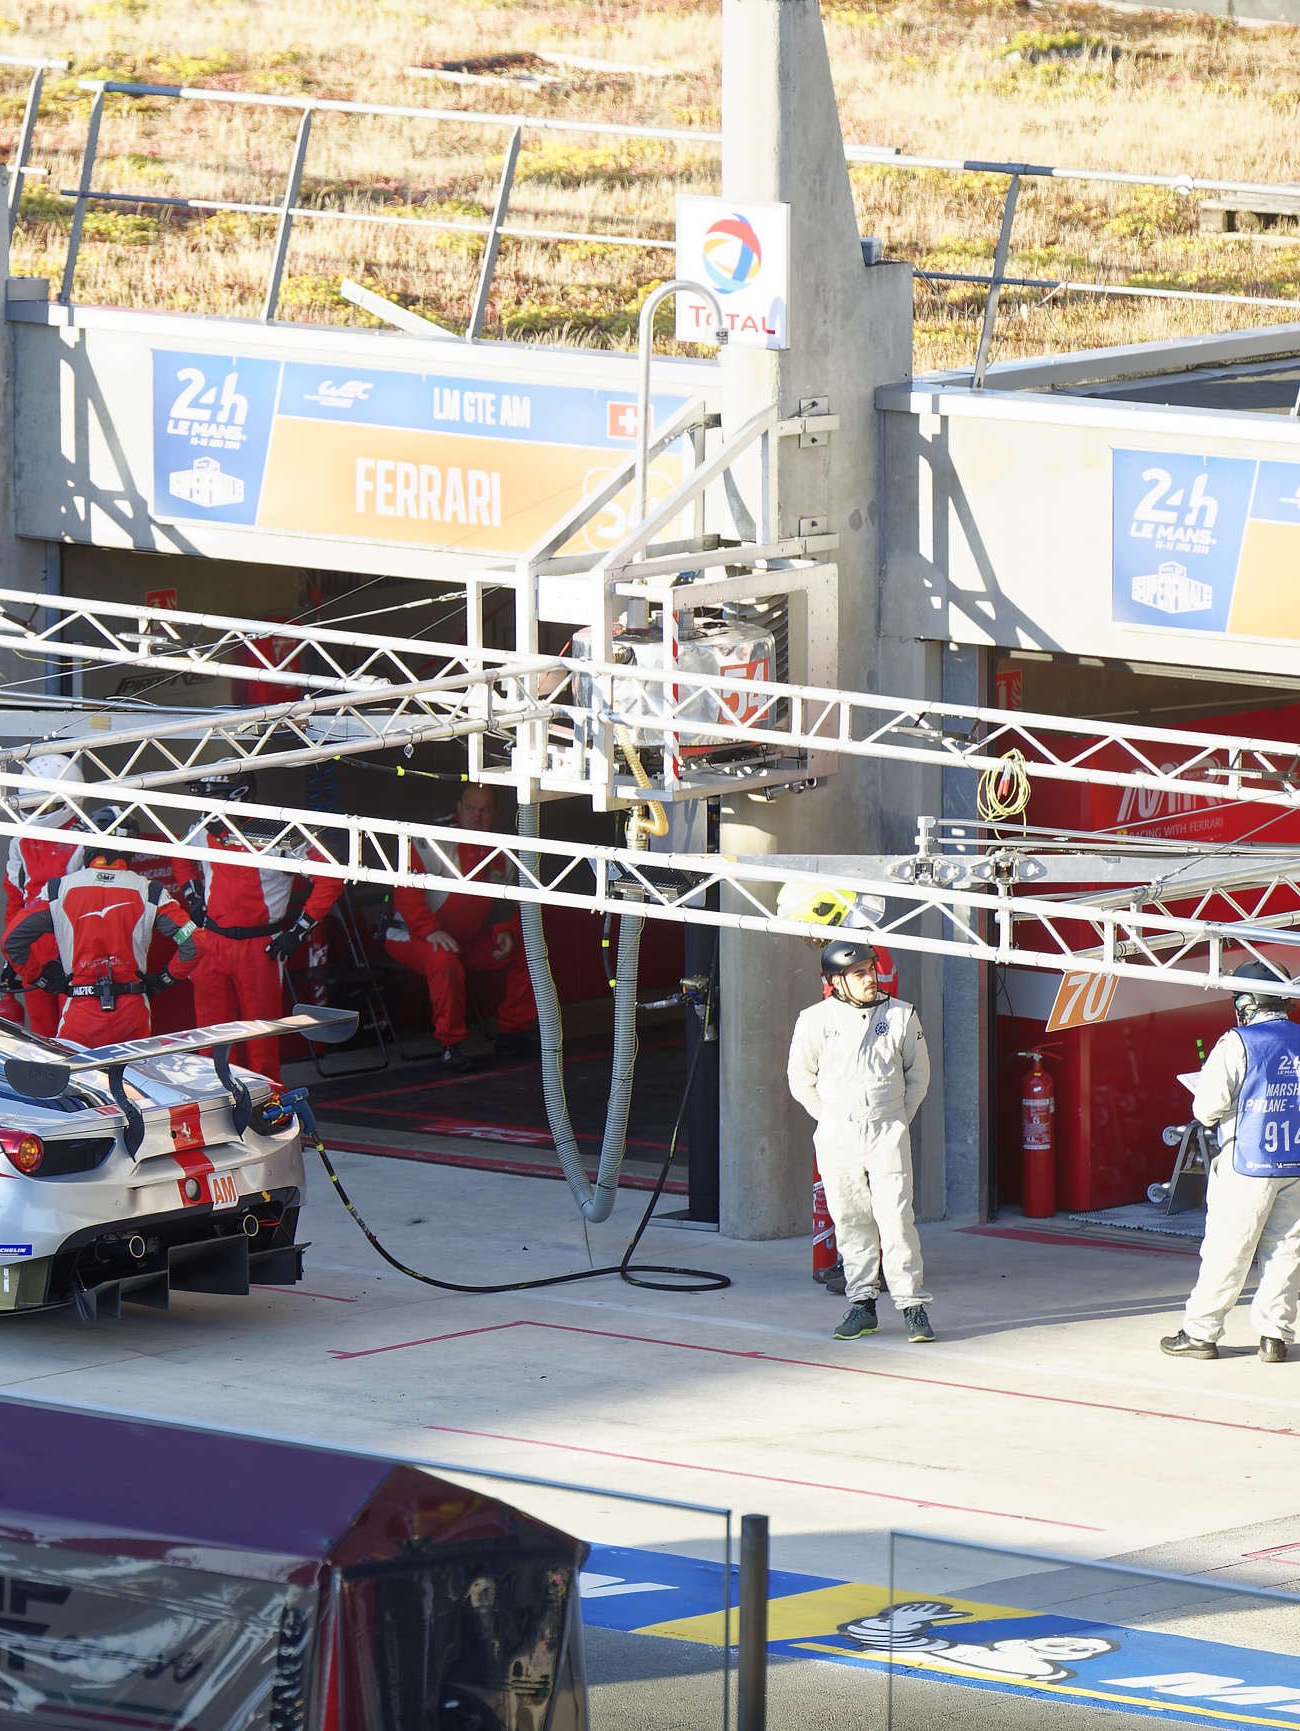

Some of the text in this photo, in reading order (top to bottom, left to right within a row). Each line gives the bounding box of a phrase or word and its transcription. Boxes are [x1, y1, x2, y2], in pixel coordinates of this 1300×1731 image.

[433, 387, 531, 429] LM GTE AM
[355, 456, 501, 528] FERRARI
[1130, 520, 1155, 539] LE
[1163, 822, 1187, 836] WITH
[1189, 816, 1224, 833] FERRARI
[1058, 972, 1114, 1025] 70
[212, 1177, 238, 1207] AM
